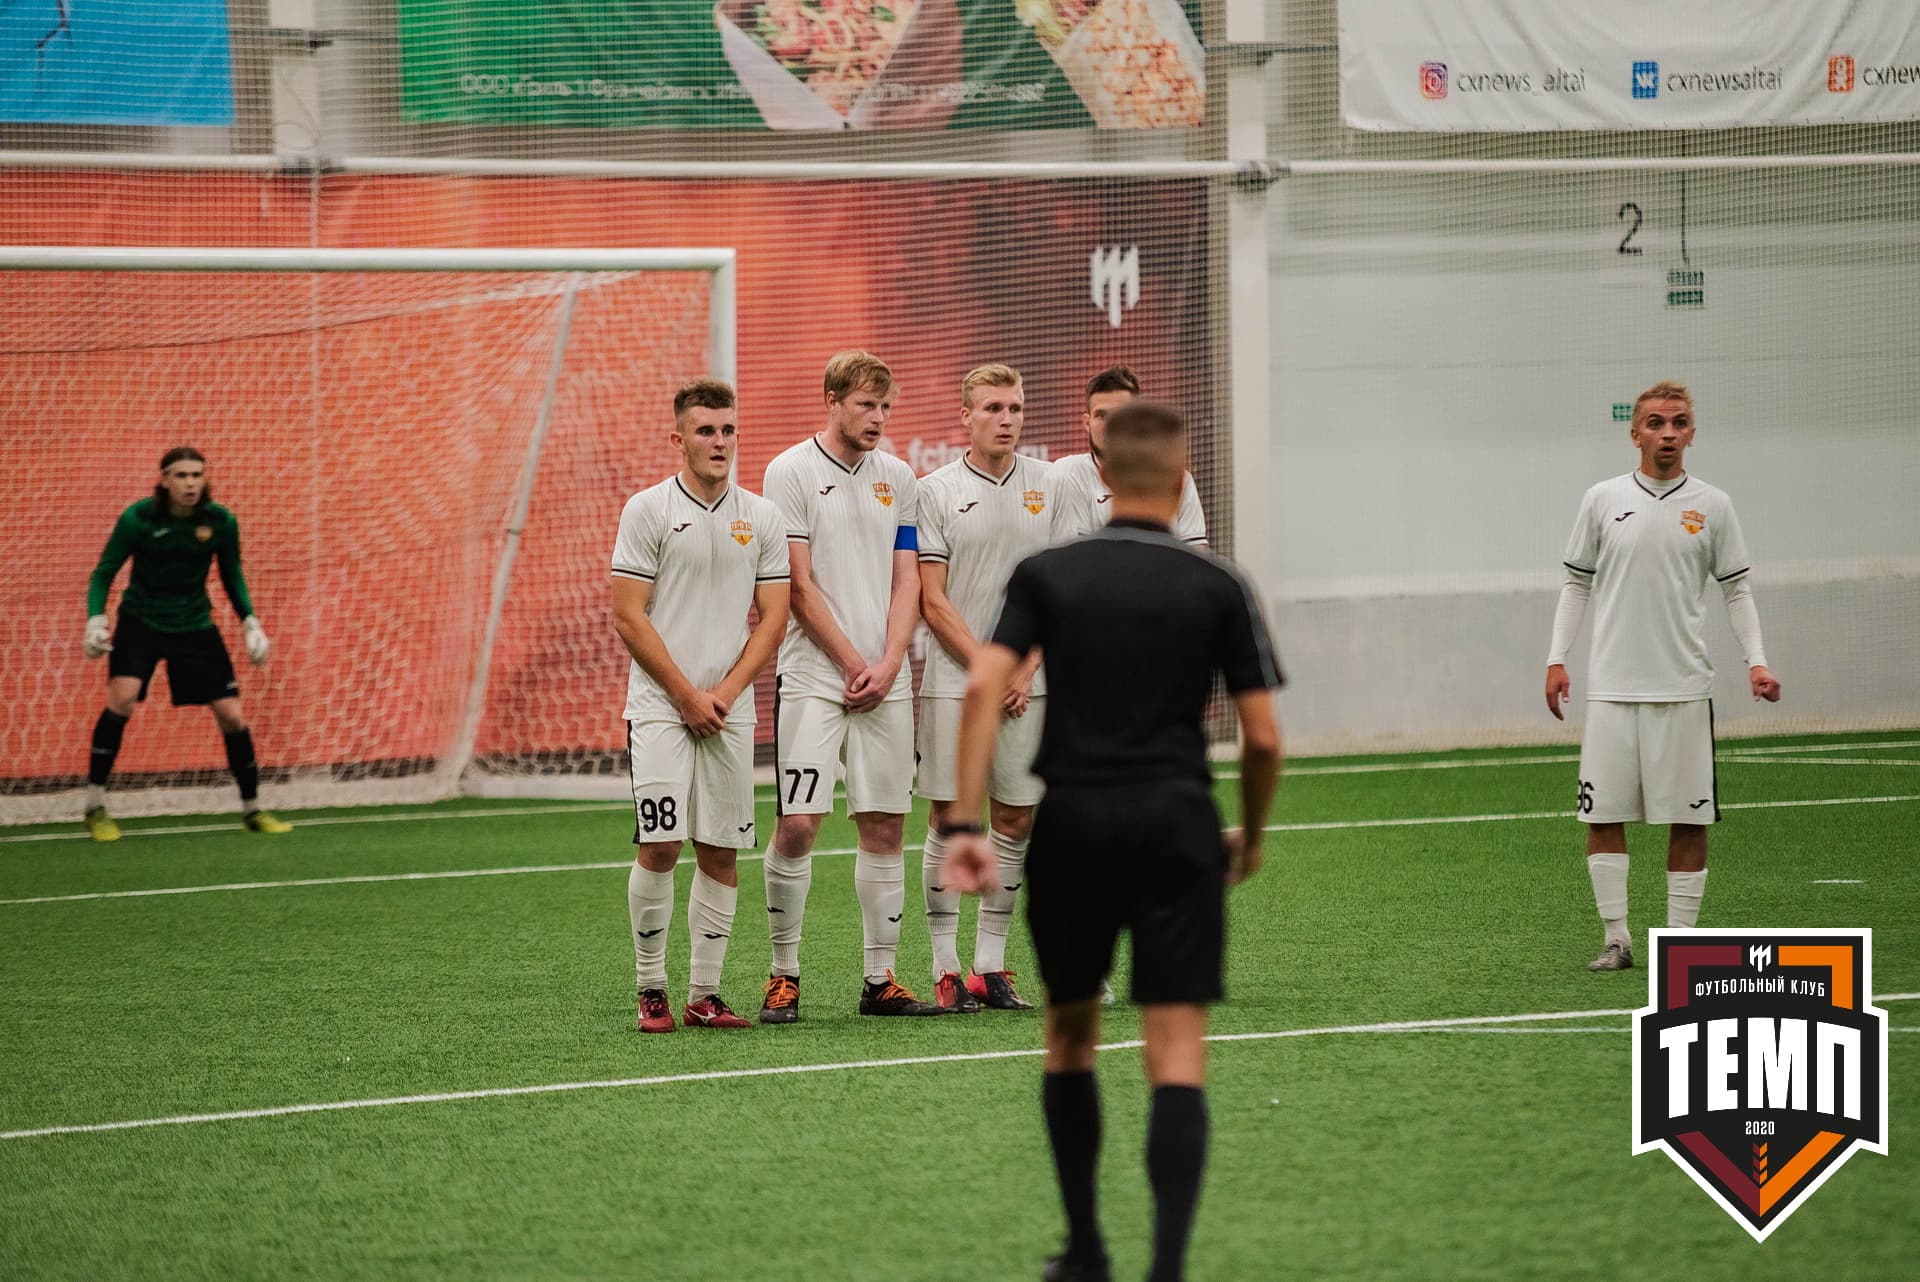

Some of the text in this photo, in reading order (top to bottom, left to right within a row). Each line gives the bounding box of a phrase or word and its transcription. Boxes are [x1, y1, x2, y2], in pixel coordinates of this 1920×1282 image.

[1667, 64, 1783, 93] cxnewsaltai
[1618, 203, 1643, 255] 2
[785, 768, 819, 804] 77
[640, 796, 677, 832] 98
